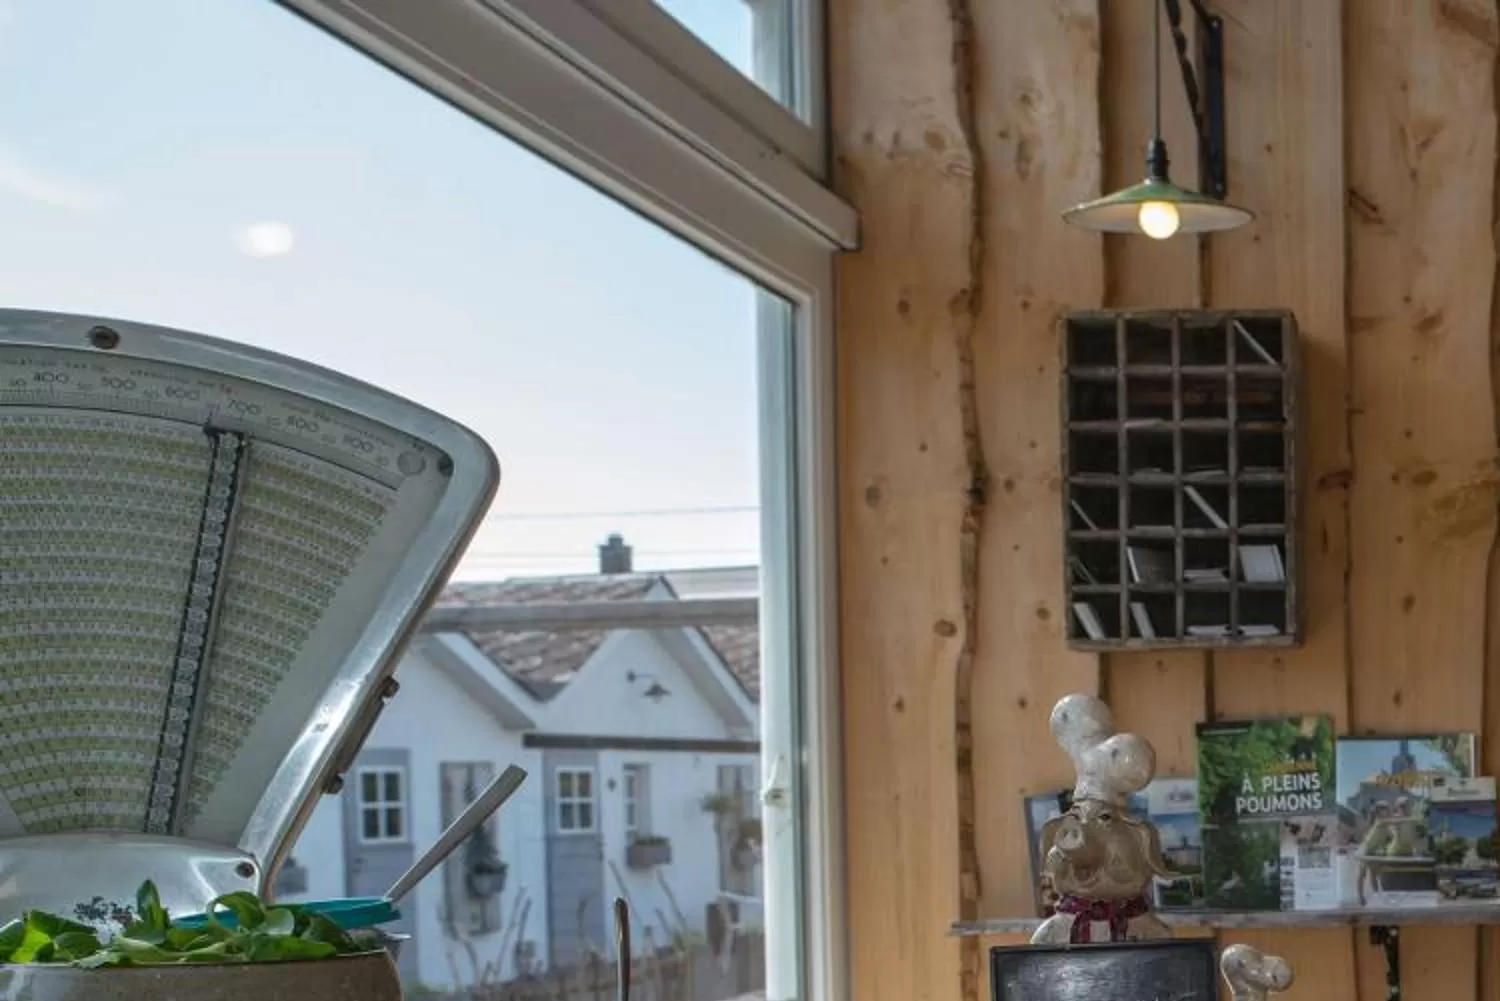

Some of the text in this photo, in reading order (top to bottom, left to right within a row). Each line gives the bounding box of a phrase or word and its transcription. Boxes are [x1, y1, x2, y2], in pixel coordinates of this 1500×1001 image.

[1241, 771, 1322, 794] À PLEINS
[1235, 792, 1323, 816] POUMONS
